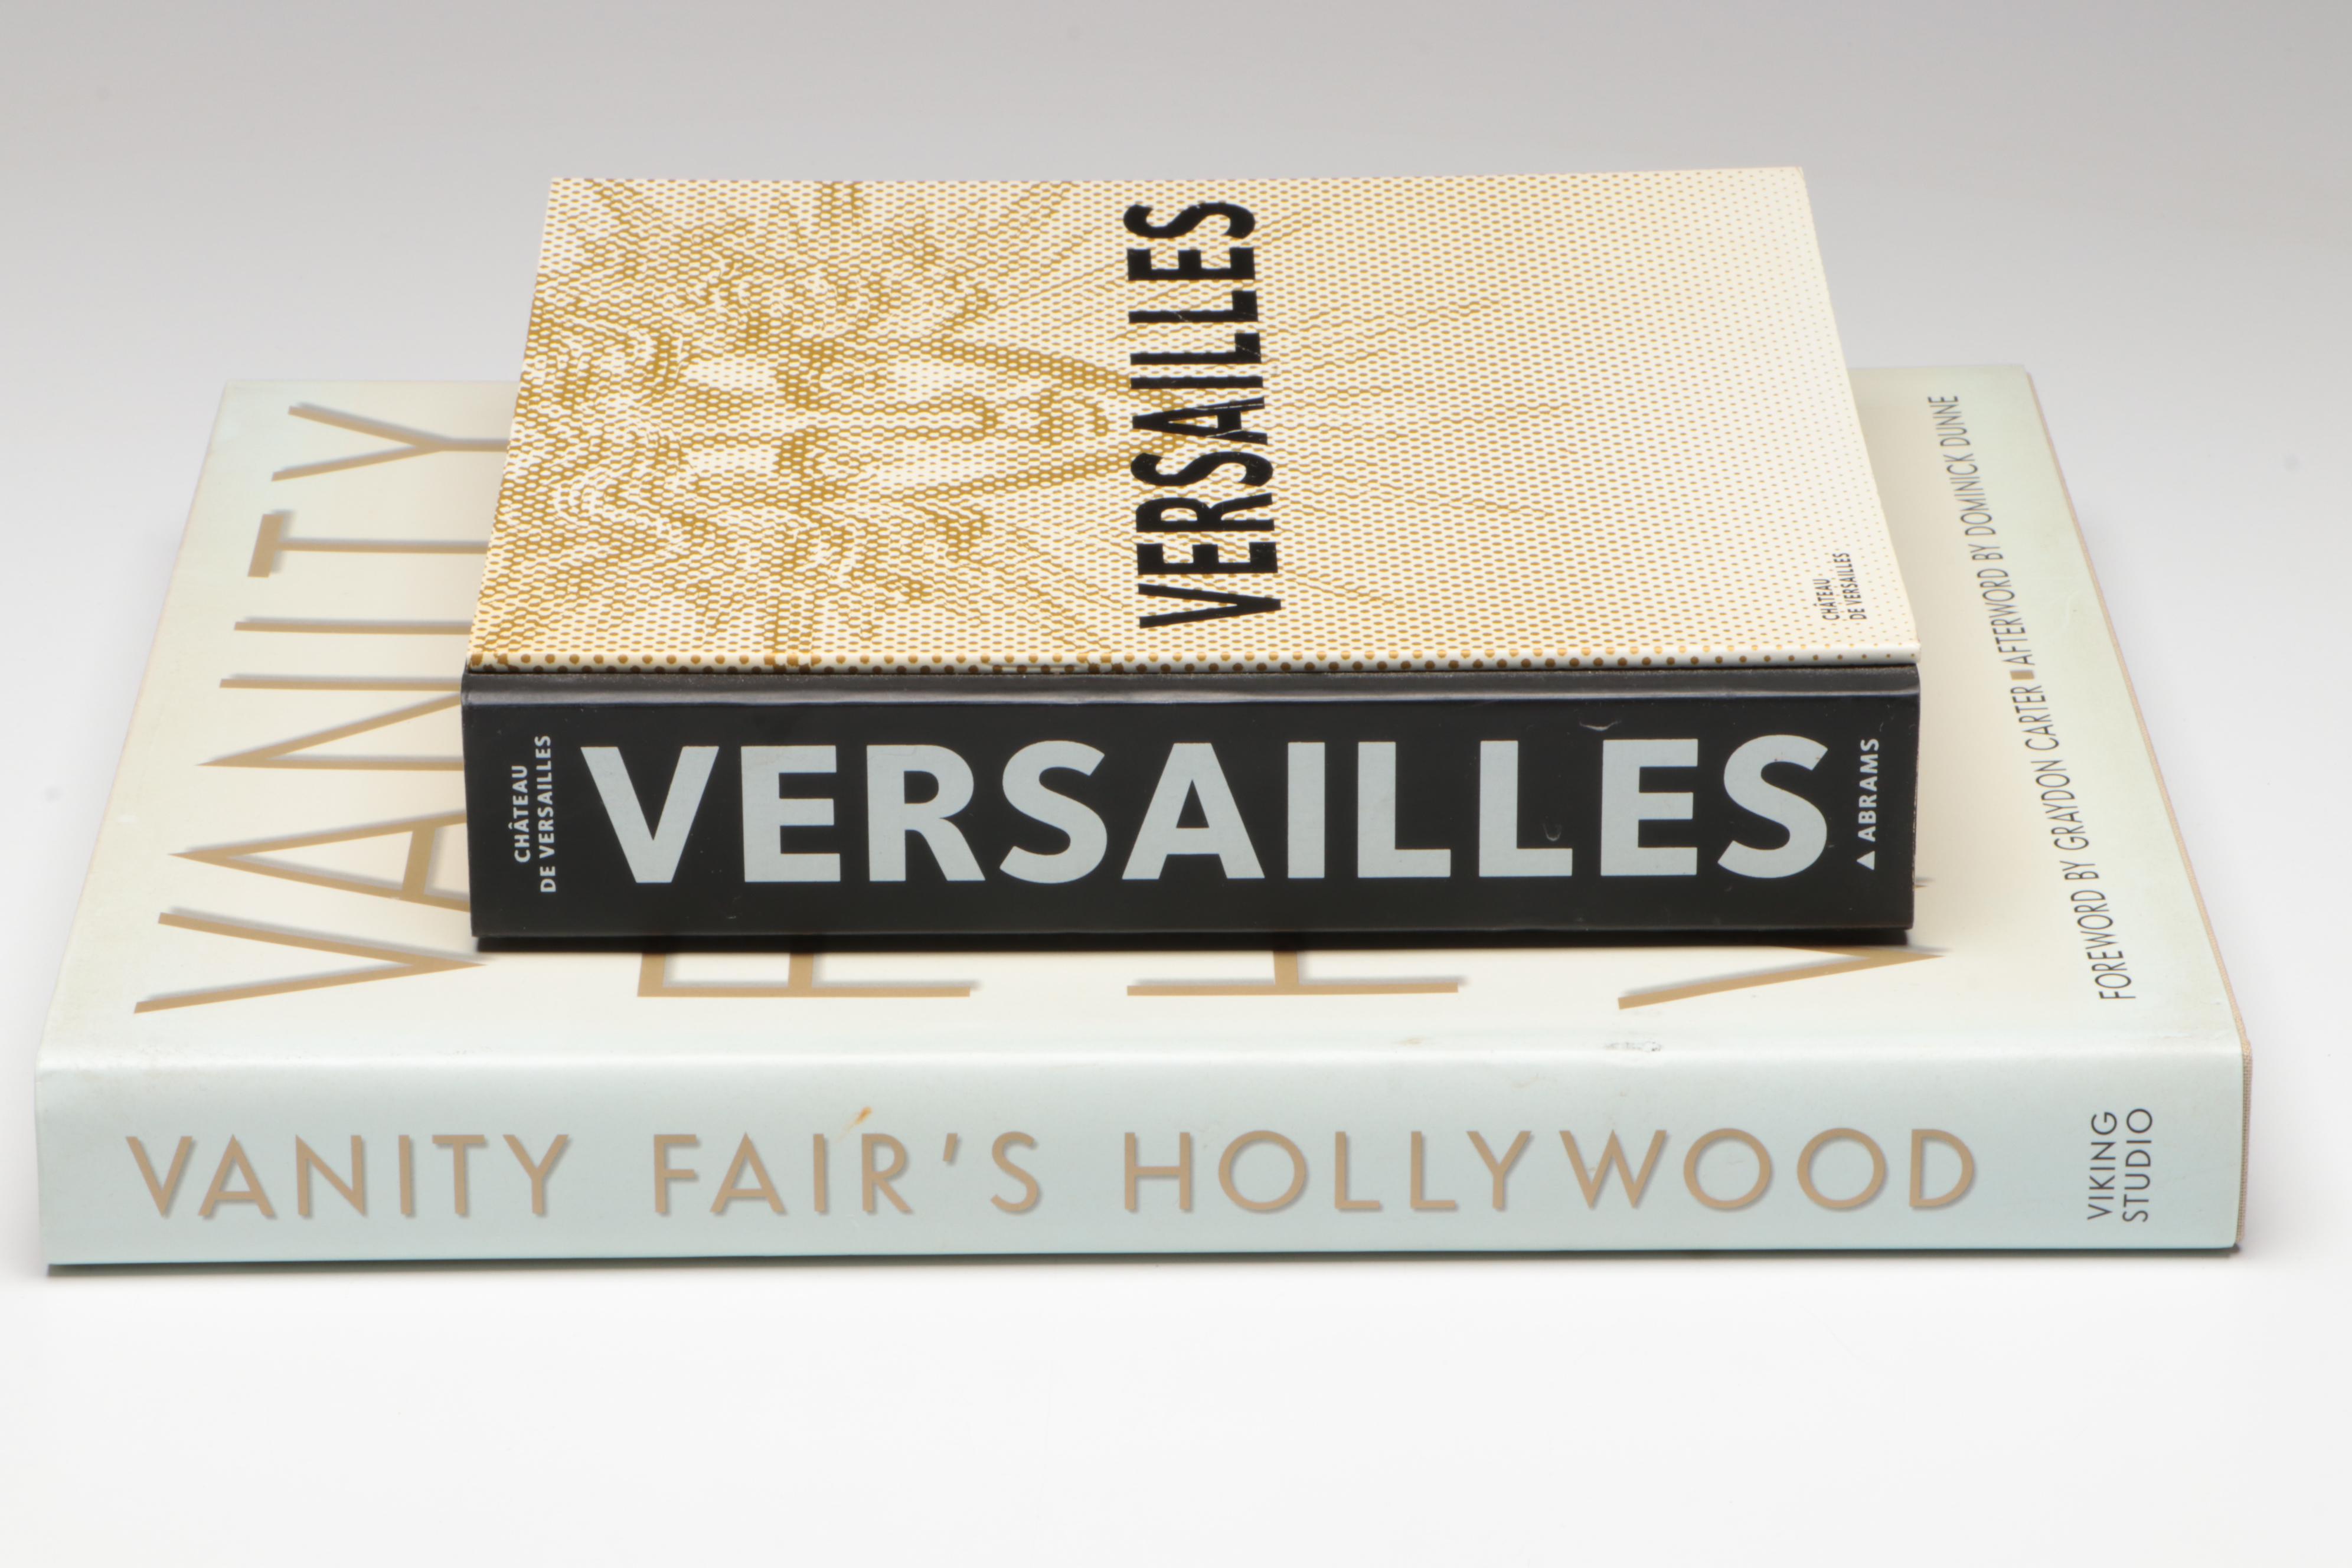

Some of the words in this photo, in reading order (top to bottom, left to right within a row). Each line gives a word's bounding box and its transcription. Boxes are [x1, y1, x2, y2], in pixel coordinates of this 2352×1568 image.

[1123, 202, 1281, 628] VERSAILLES
[1928, 396, 1970, 446] DUNNE
[1943, 453, 1996, 535] DOMINICK
[1832, 553, 1863, 606] VERSAILLES
[1968, 544, 2004, 560] BY
[1812, 579, 1840, 620] CHÂTEAU
[1847, 608, 1867, 620] DE
[1977, 569, 2035, 665] AFTERWORD
[133, 403, 509, 1014] VANITY
[2010, 685, 2059, 750] CARTER
[508, 765, 531, 863] CHÂTEAU
[534, 735, 555, 858] VERSAILLES
[580, 734, 1829, 884] VERSAILLES
[1858, 739, 1879, 842] ABRAMS
[2031, 760, 2089, 850] GRAYDON
[540, 866, 556, 893] DE
[2060, 860, 2099, 880] BY
[2070, 890, 2136, 999] FOREWORD
[125, 1133, 571, 1219] VANITY
[653, 1130, 1043, 1217] FAIR'S
[1124, 1126, 1978, 1213] HOLLYWOOD
[2087, 1111, 2118, 1220] VIKING
[2122, 1108, 2152, 1222] STUDIO
